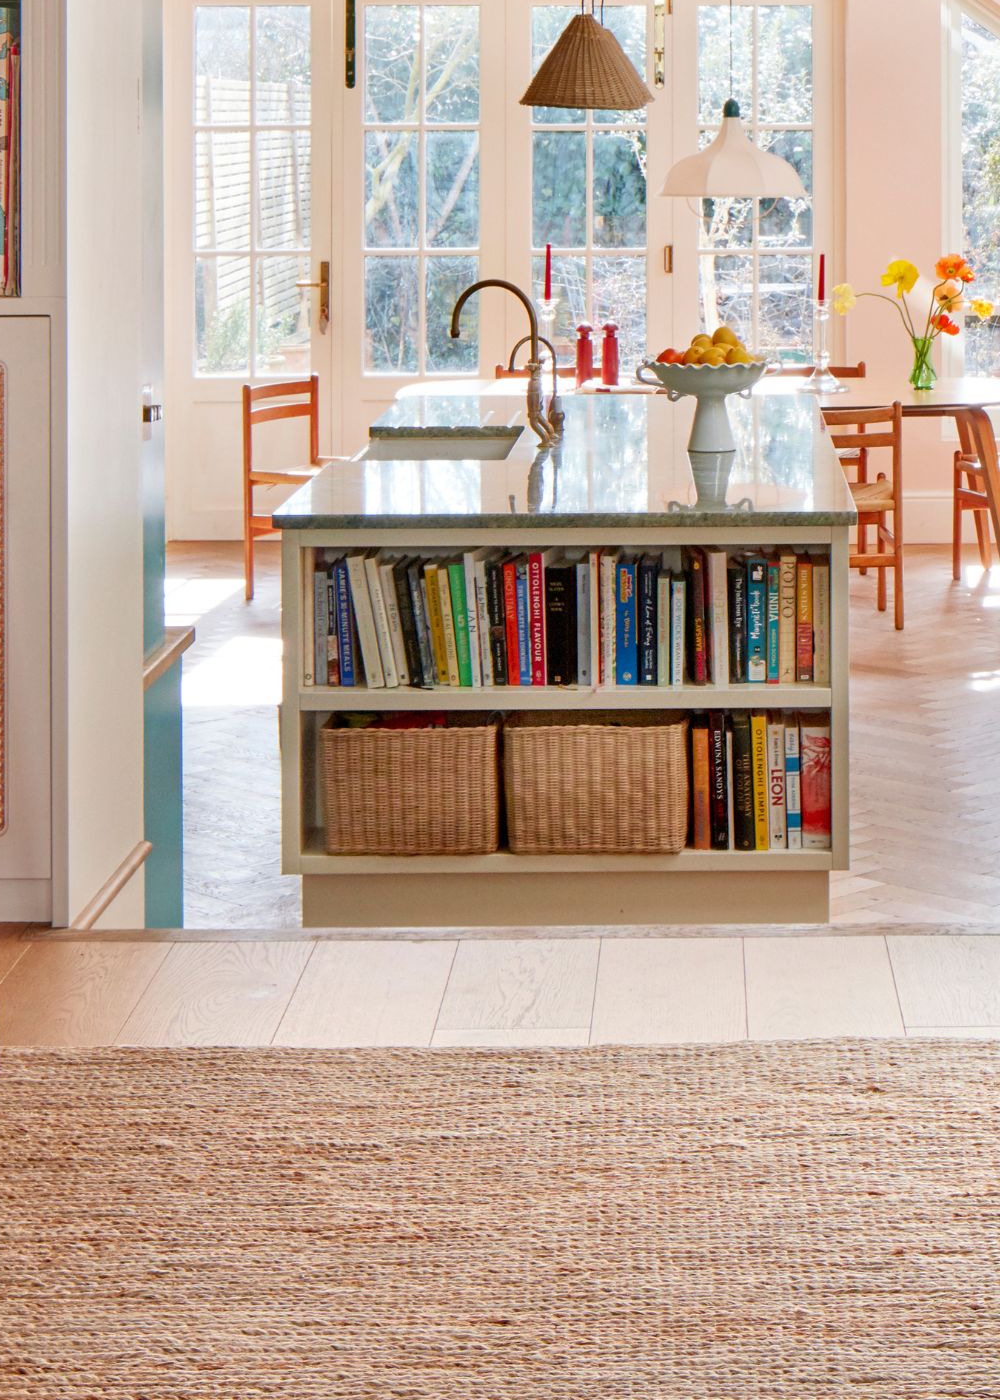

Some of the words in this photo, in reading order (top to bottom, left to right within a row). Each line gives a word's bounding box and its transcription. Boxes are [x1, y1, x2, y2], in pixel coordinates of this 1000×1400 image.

[531, 562, 541, 619] OTTOLENGHI
[781, 561, 795, 619] POLPO
[800, 569, 808, 590] RICK
[338, 568, 348, 601] JAMIE'S
[343, 646, 351, 673] MEALS
[506, 597, 515, 620] ITALY
[769, 592, 779, 622] INDIA
[534, 622, 542, 662] FLAVOUR
[694, 617, 703, 652] RAMSAY'S
[798, 622, 812, 655] INDIA
[714, 730, 722, 764] EDWINA
[742, 753, 750, 771] THE
[755, 728, 764, 787] OTTOLENGHI
[715, 766, 724, 800] SANDYS
[736, 774, 744, 811] COLOUR
[743, 773, 752, 817] ANATOMY
[770, 768, 784, 807] LEON
[757, 791, 765, 823] SIMPLE
